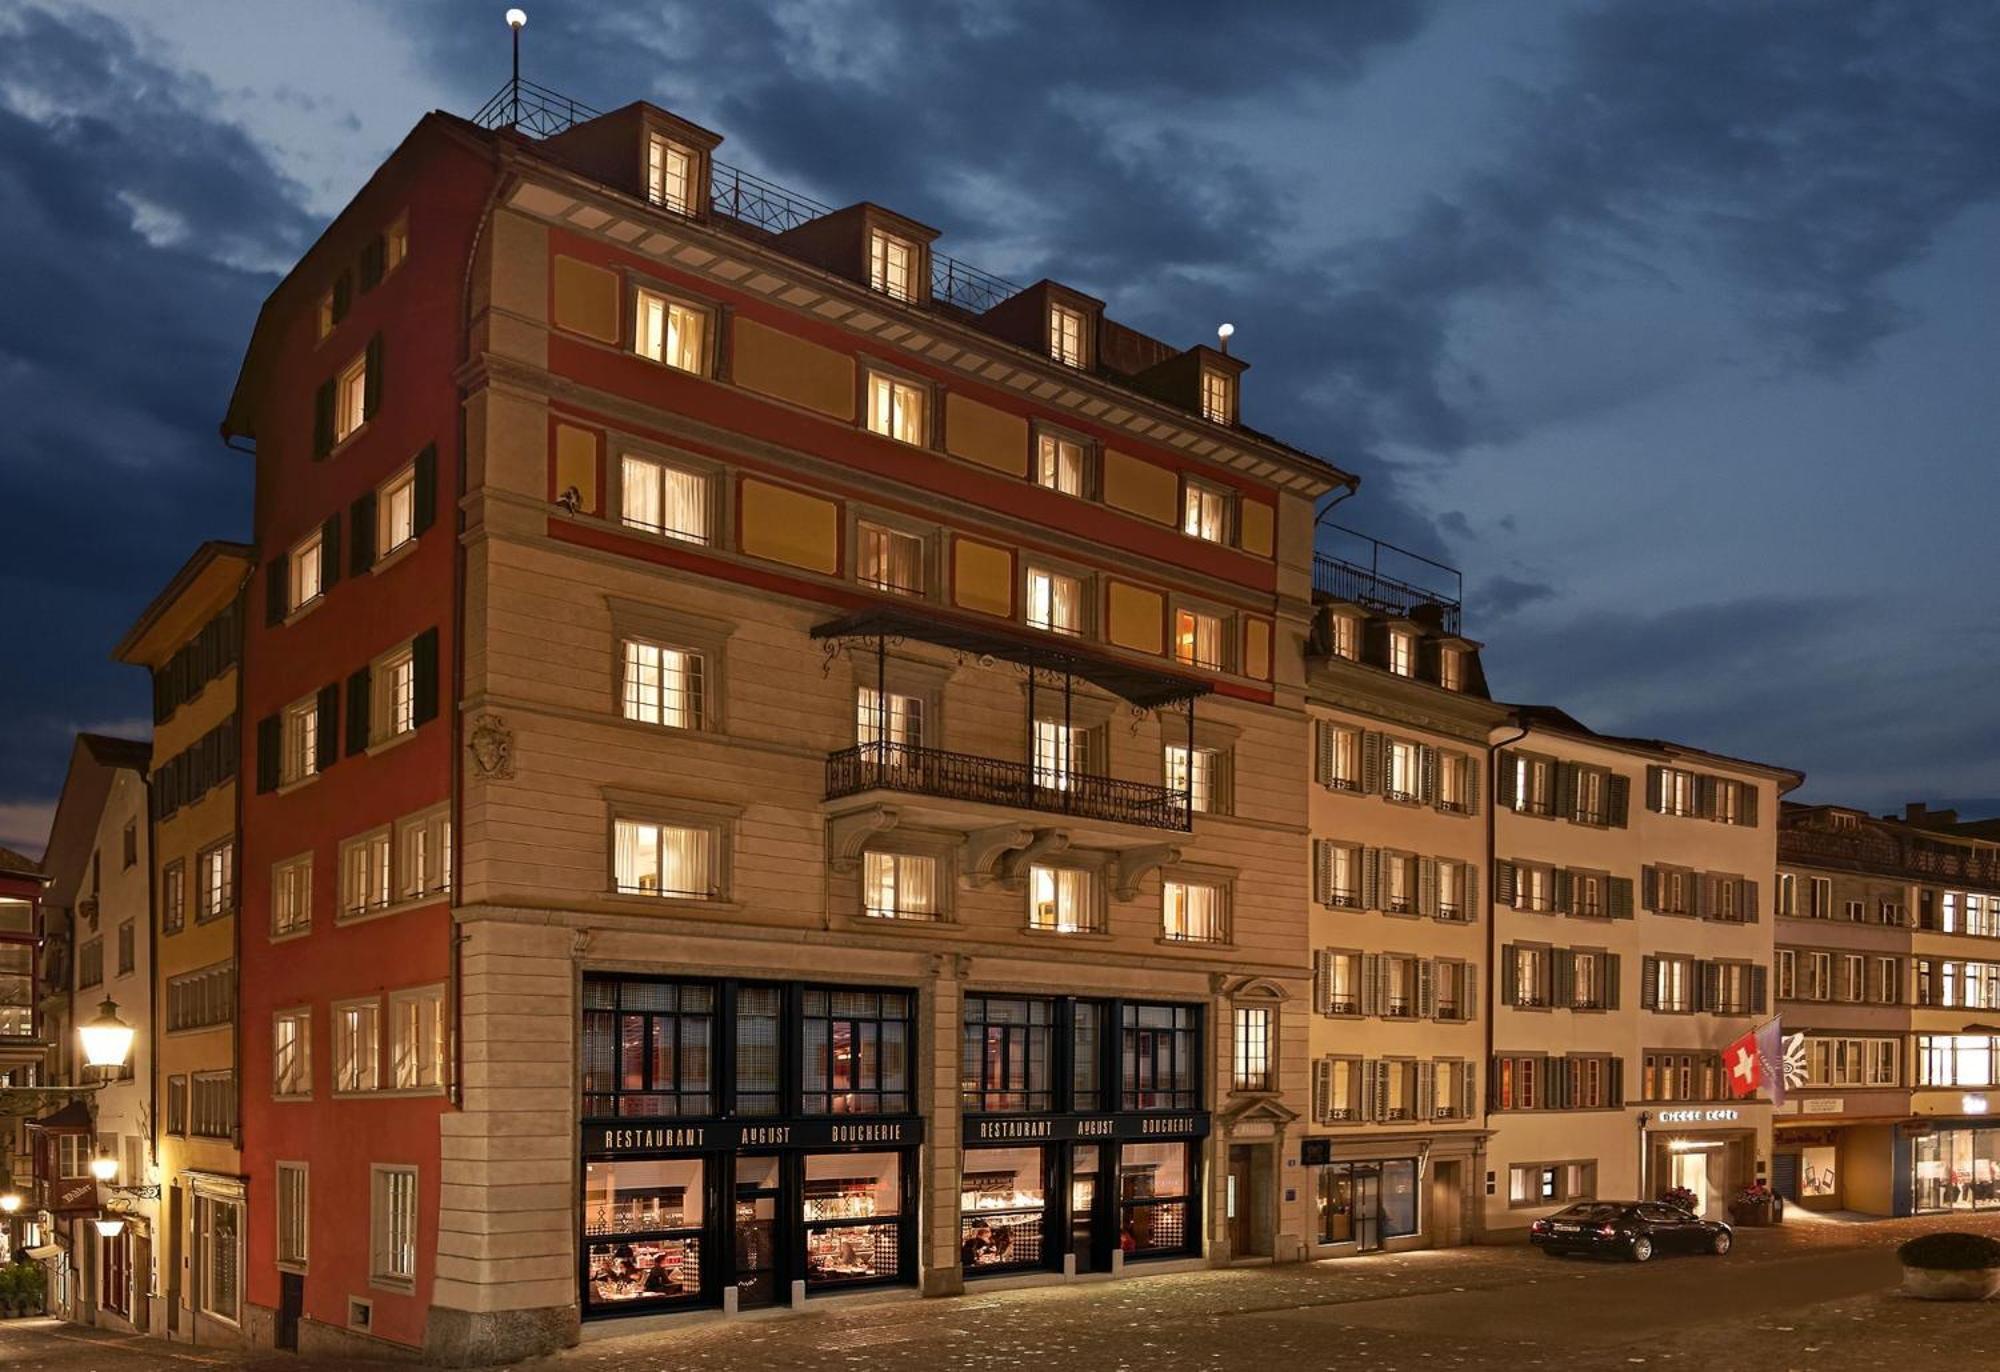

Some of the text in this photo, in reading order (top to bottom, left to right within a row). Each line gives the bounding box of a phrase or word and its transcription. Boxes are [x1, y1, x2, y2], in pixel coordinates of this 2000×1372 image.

[605, 1124, 901, 1149] RESTAURANT AUGUST BOUCHERIE
[980, 1118, 1194, 1138] RESTAURANT AUGUST BOUCHERIE
